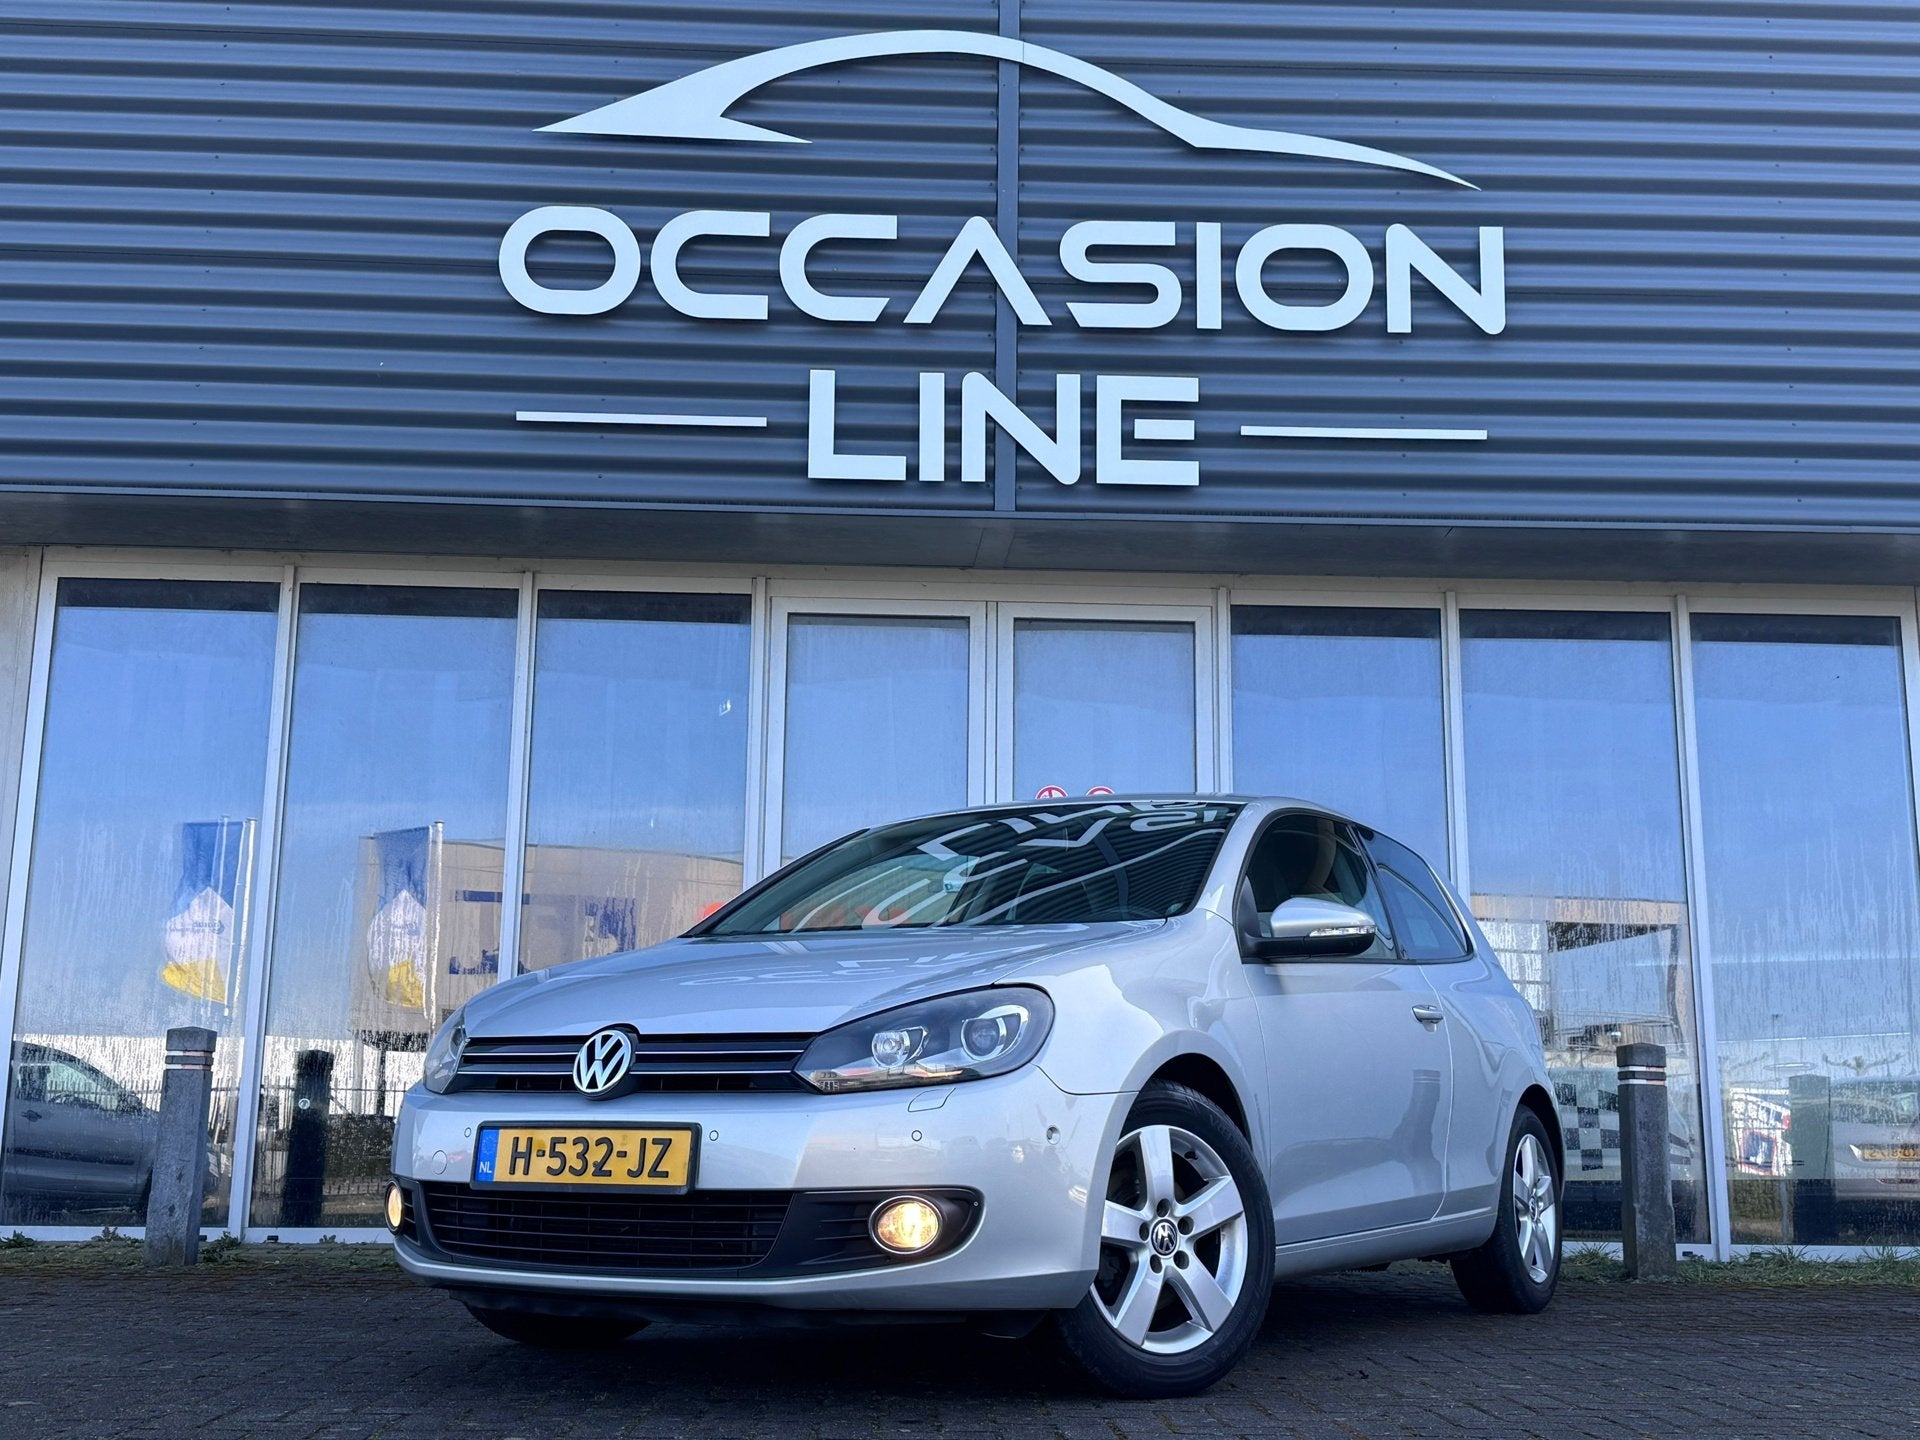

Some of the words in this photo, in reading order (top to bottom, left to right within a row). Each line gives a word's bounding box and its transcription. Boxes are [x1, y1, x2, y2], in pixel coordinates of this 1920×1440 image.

[498, 205, 1506, 335] OCCASION
[808, 369, 1200, 486] LINE
[479, 1161, 493, 1174] NL
[508, 1136, 673, 1179] H-532-JZ
